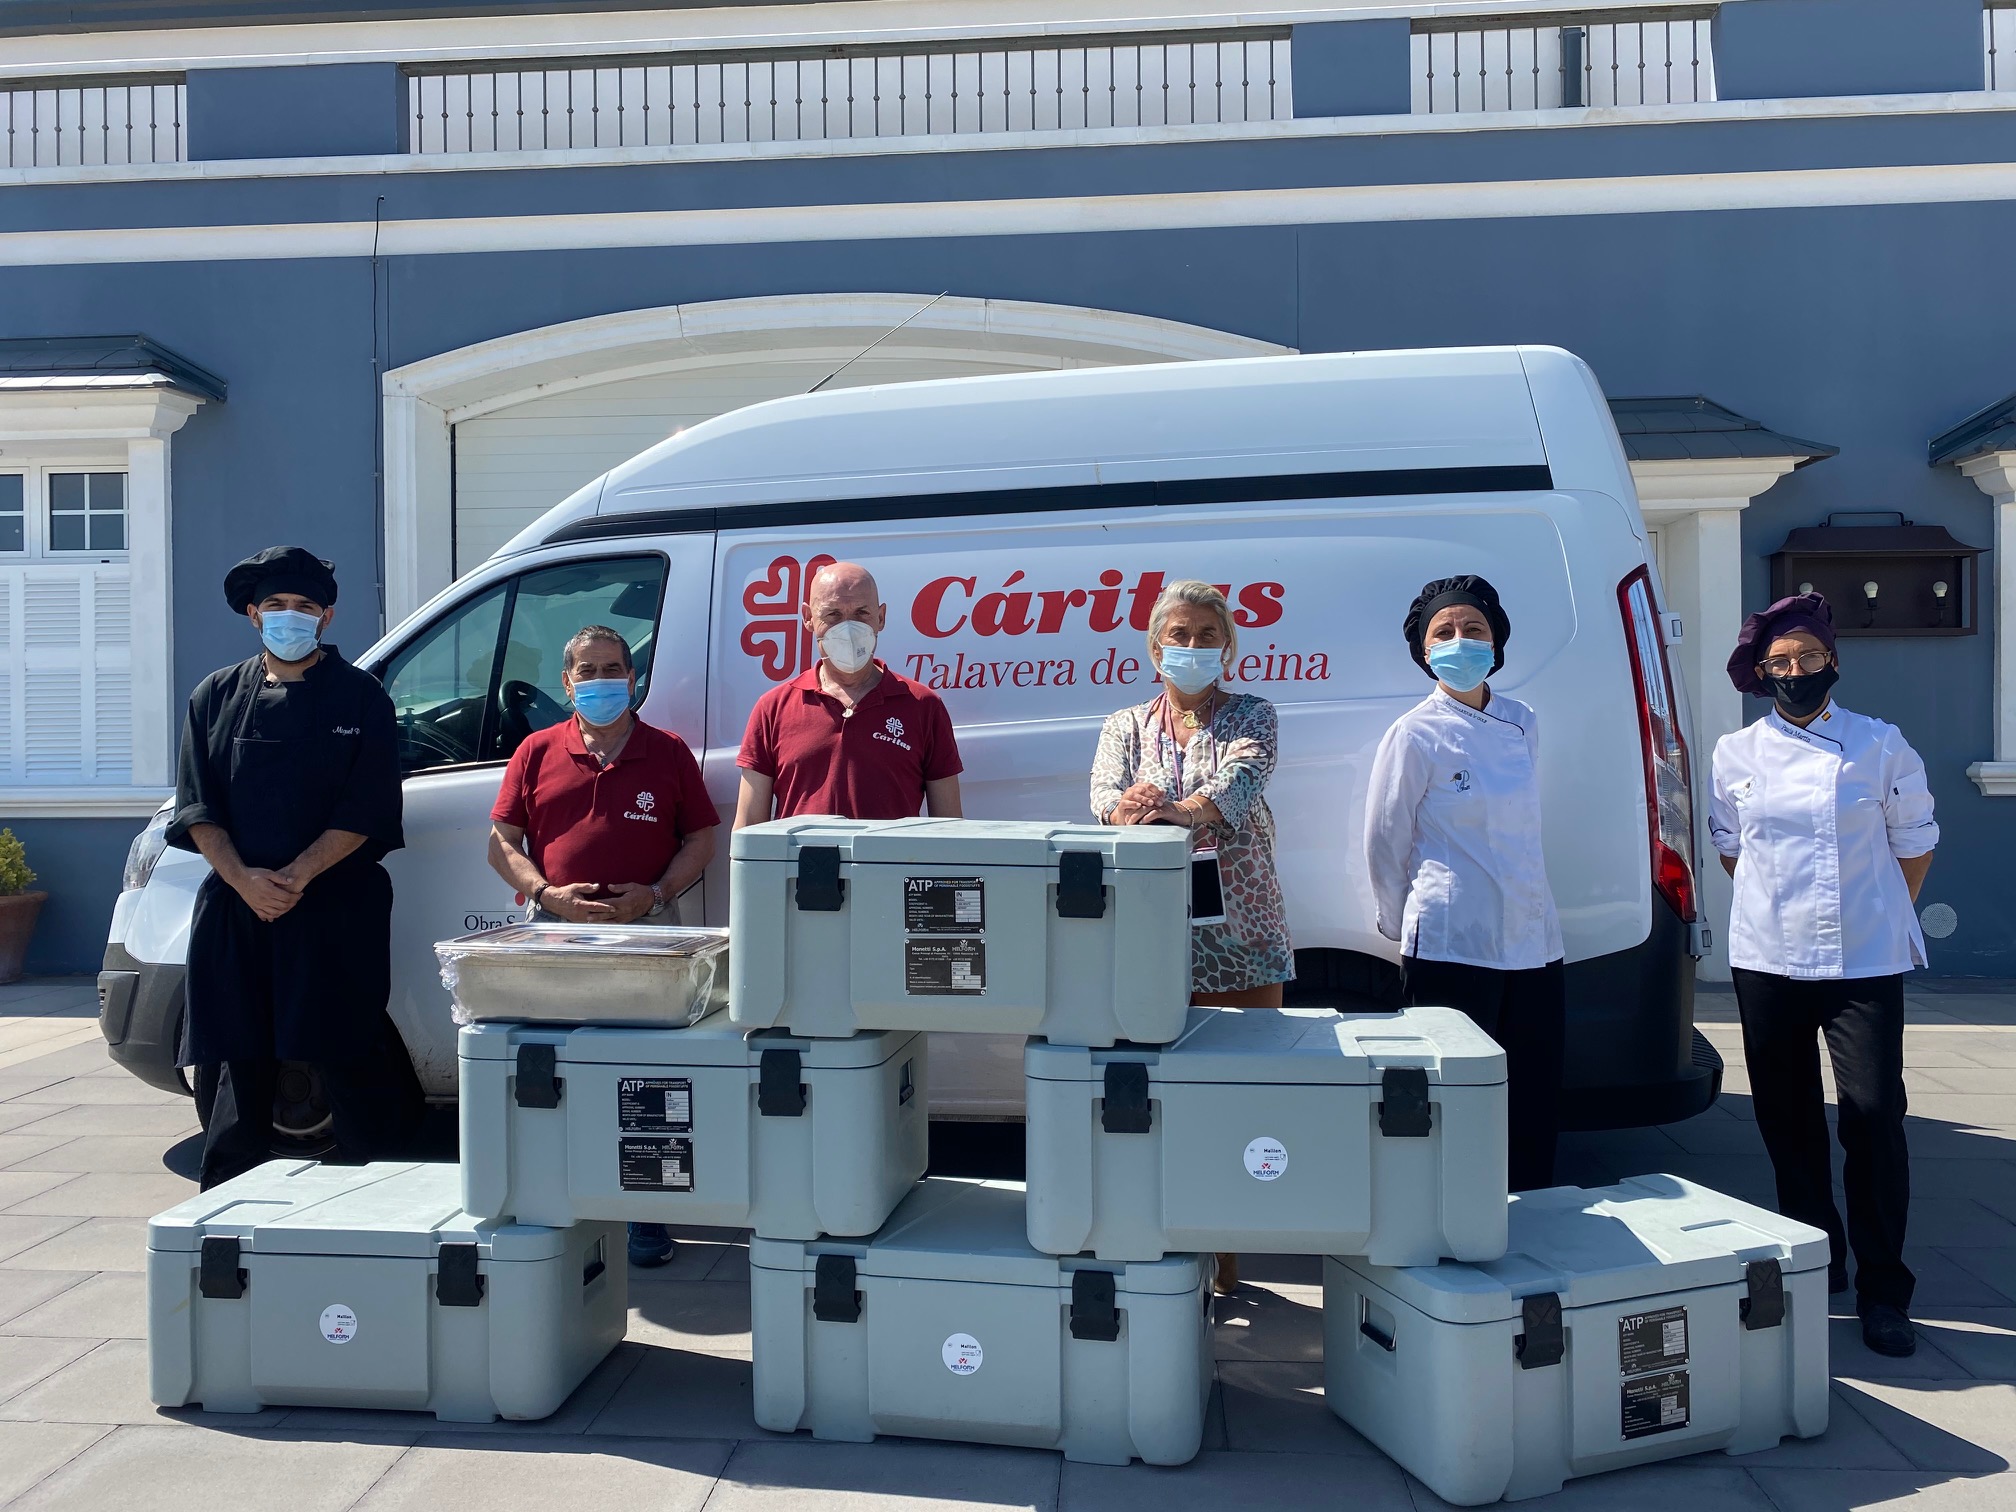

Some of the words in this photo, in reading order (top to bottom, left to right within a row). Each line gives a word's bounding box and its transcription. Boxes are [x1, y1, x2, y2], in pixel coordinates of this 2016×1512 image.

[911, 569, 1285, 638] Cárits
[905, 652, 1078, 690] Talavera
[1091, 648, 1139, 685] de
[1223, 644, 1331, 682] eina
[332, 725, 354, 736] Miguel
[872, 732, 911, 751] Cáritas
[623, 811, 657, 823] Cáritas
[908, 880, 933, 892] ATP
[464, 914, 502, 931] Obra
[622, 1081, 644, 1092] ATP
[1622, 1316, 1644, 1332] ATP
